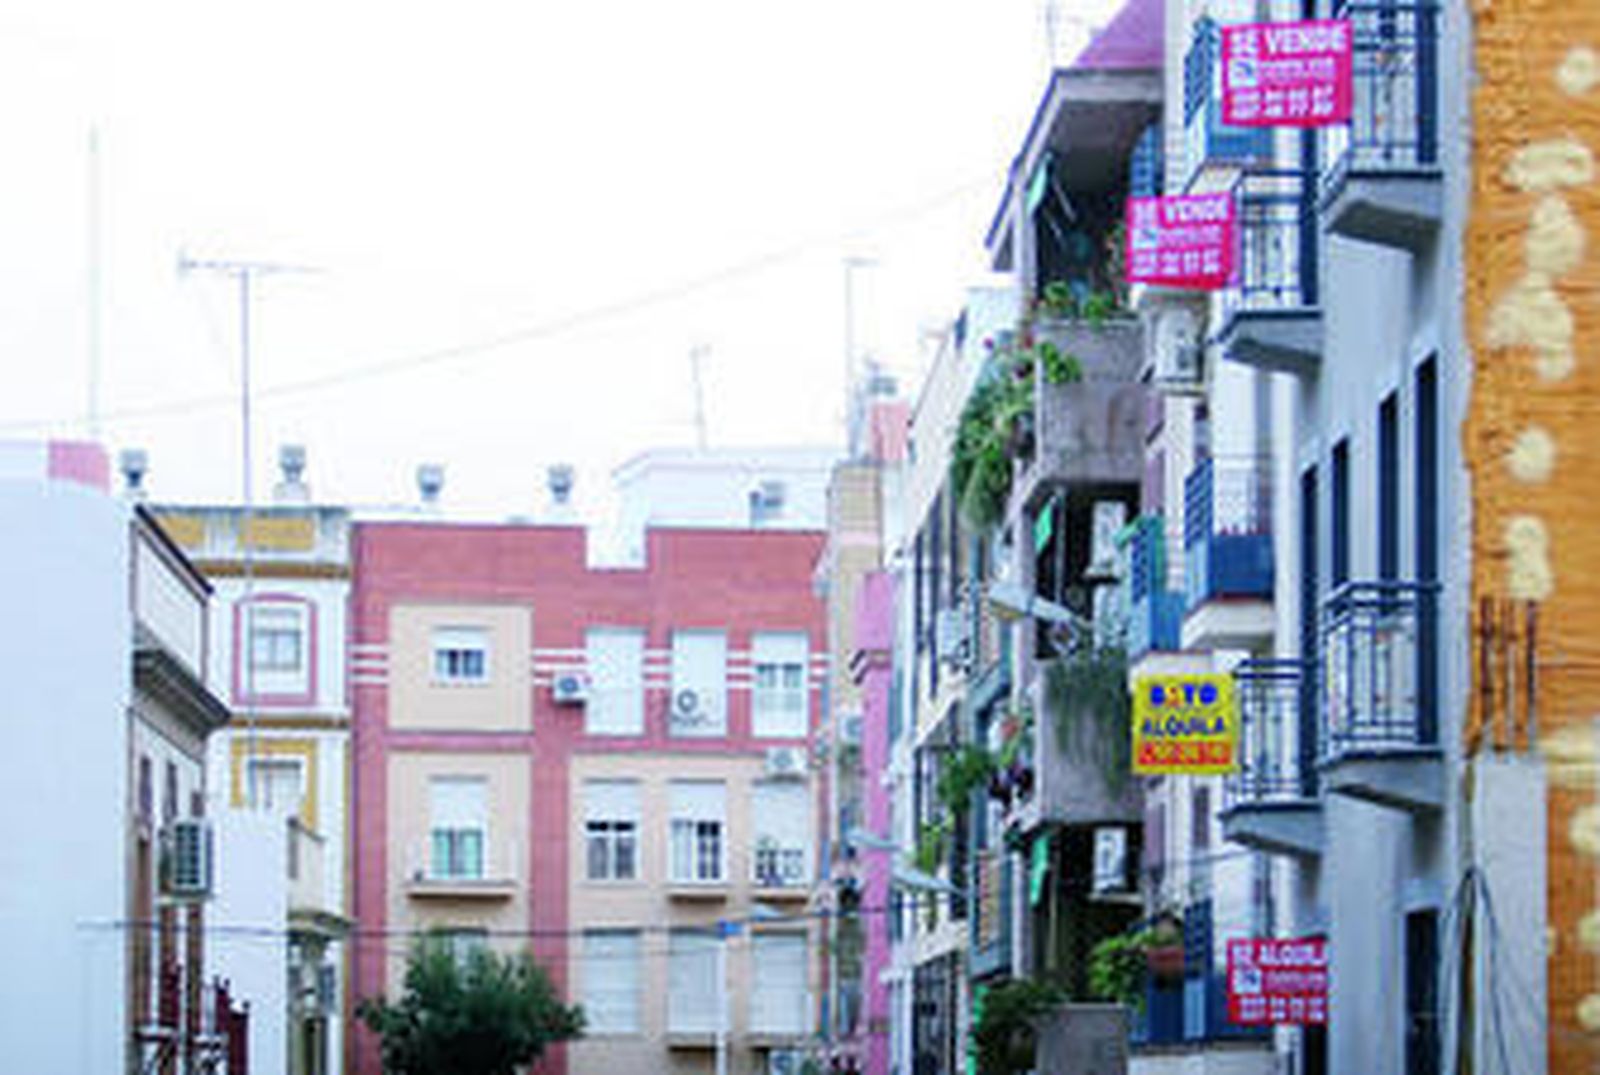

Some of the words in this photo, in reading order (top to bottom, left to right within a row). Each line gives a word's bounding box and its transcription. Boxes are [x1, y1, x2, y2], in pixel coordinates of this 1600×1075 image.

[1229, 29, 1259, 55] SE
[1263, 25, 1347, 54] VENDE
[1164, 198, 1229, 223] VENDE
[1142, 714, 1225, 737] ALQUILA
